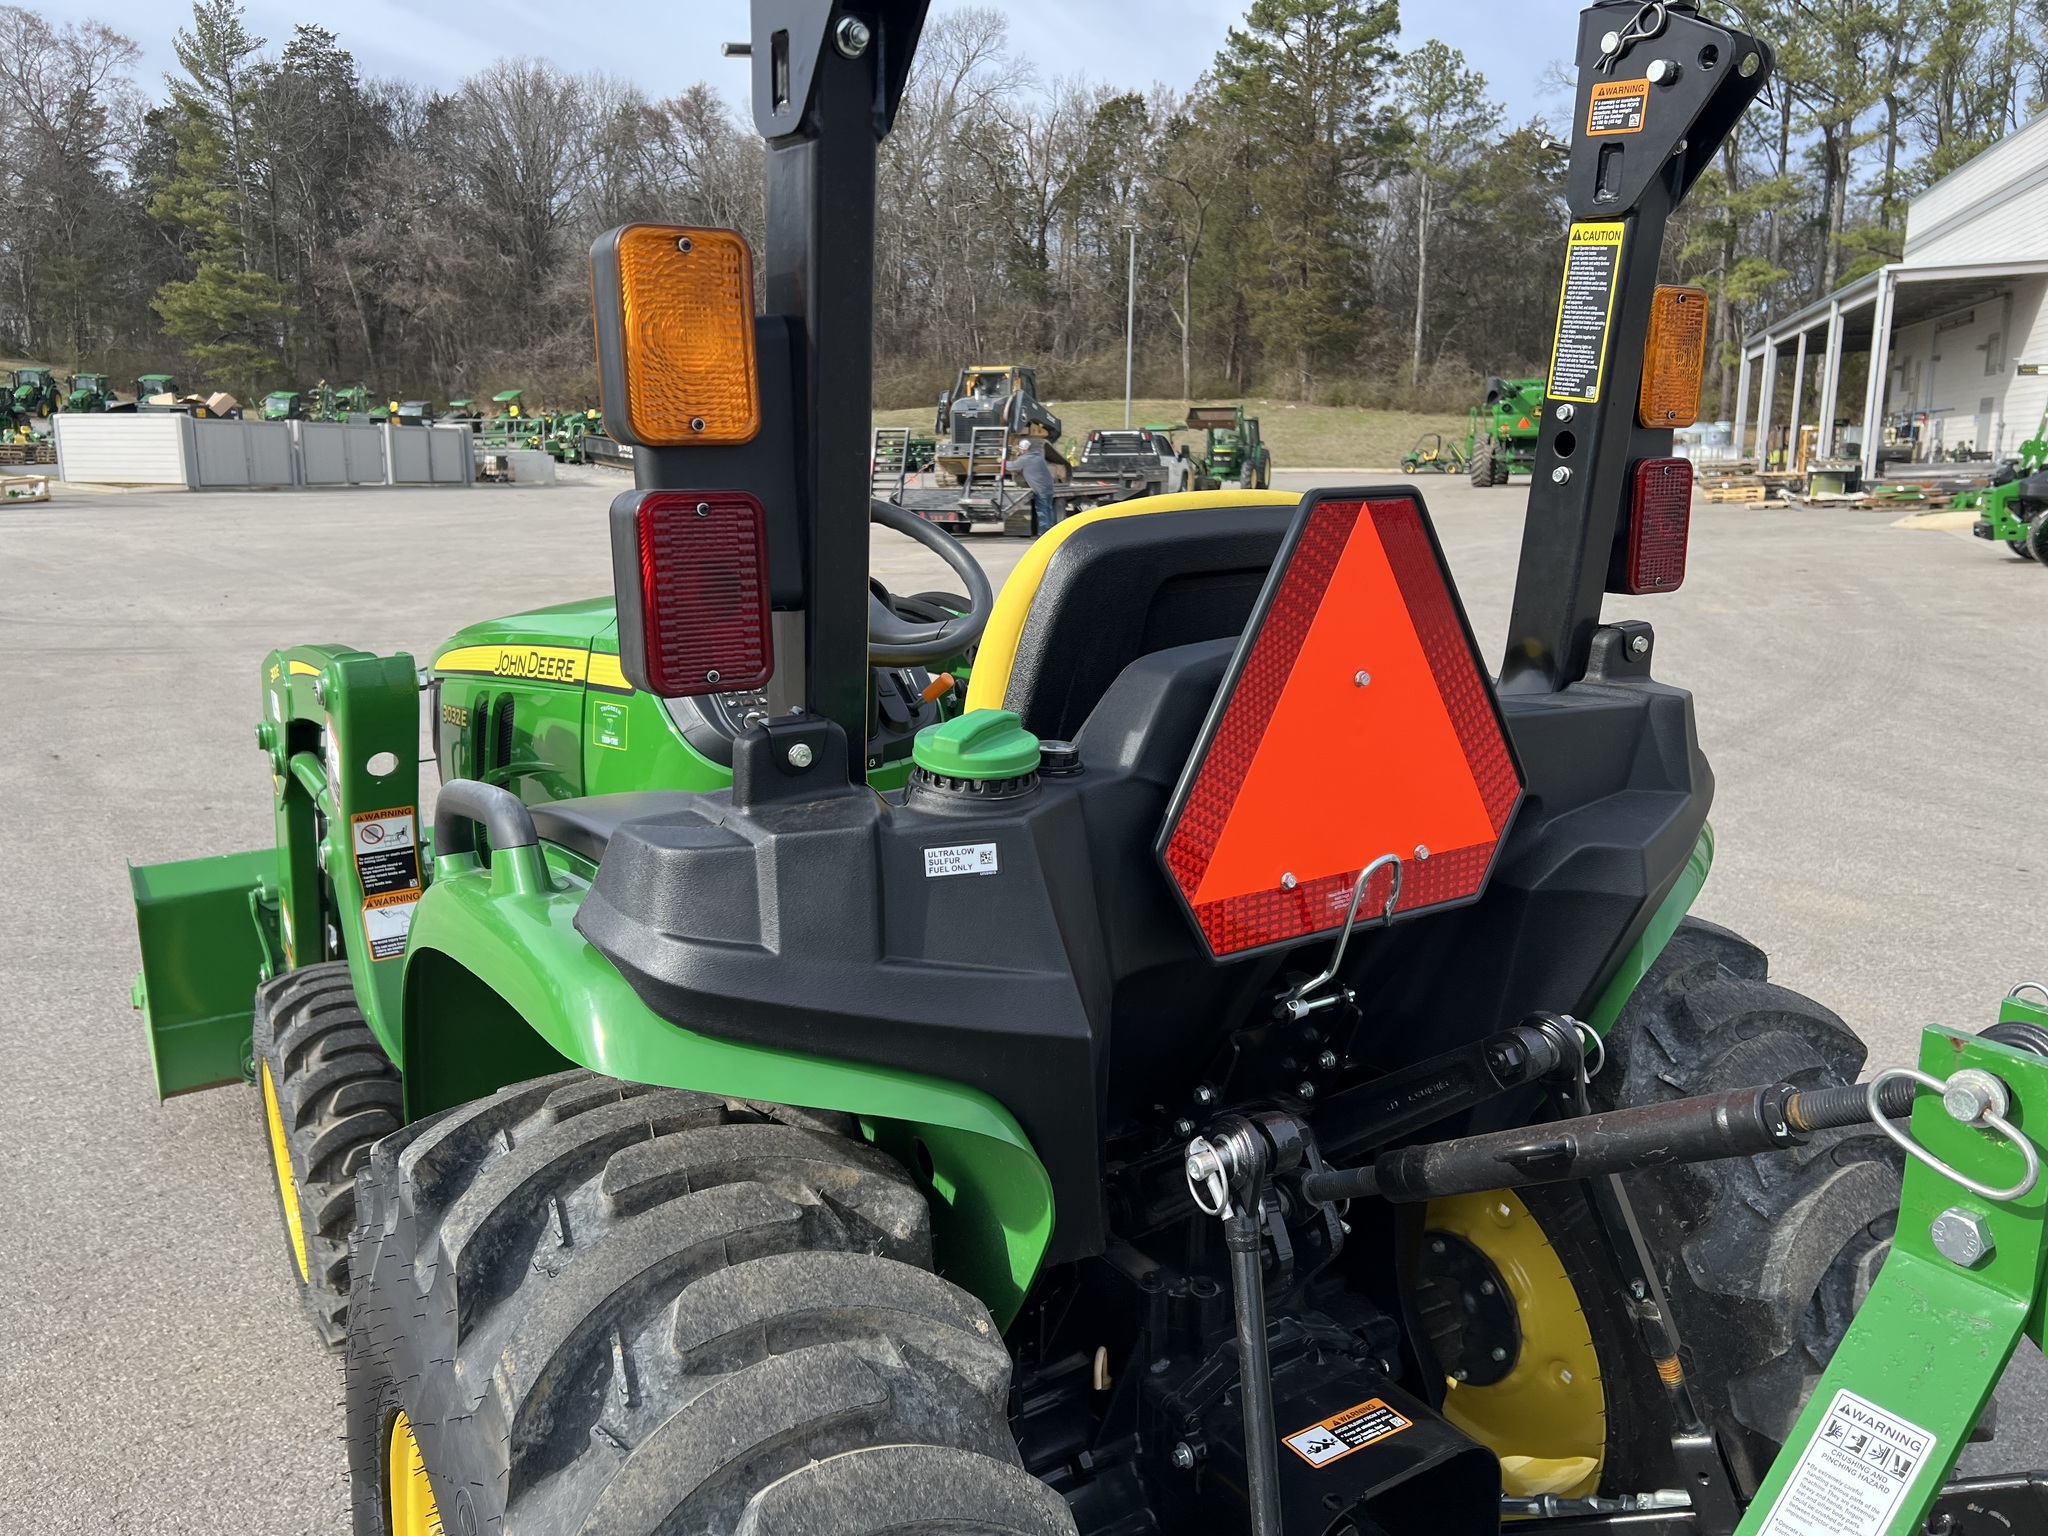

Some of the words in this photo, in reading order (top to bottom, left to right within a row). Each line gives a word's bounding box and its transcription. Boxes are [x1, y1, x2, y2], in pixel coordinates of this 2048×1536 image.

[1606, 84, 1644, 95] WARNING
[1582, 230, 1622, 241] CAUTION
[528, 651, 576, 679] DEERE
[443, 704, 468, 728] 3032E
[364, 808, 412, 821] WARNING
[928, 850, 955, 858] ULTRA
[929, 857, 960, 866] SULFUR
[929, 866, 949, 874] FUEL
[951, 864, 973, 872] ONLY
[374, 892, 420, 906] WARNING
[1340, 1404, 1376, 1422] WARNING
[1852, 1408, 1922, 1452] WARNING
[1821, 1453, 1857, 1476] PINCHING
[1858, 1473, 1889, 1494] HAZARD
[1831, 1449, 1870, 1473] CRUSHING
[1871, 1472, 1888, 1483] AND
[1807, 1470, 1829, 1486] handling
[1830, 1484, 1849, 1497] various
[1849, 1496, 1863, 1505] parts
[1871, 1507, 1880, 1515] the
[1818, 1469, 1843, 1486] extremely
[1844, 1484, 1863, 1496] careful
[1793, 1496, 1808, 1506] could
[1815, 1509, 1837, 1523] crushed
[1796, 1489, 1806, 1497] feet
[1817, 1502, 1831, 1511] other
[1832, 1509, 1845, 1520] body
[1845, 1519, 1860, 1528] parts
[1800, 1482, 1815, 1494] heavy
[1826, 1498, 1843, 1511] hands,
[1845, 1508, 1864, 1524] fingers,
[1803, 1477, 1825, 1491] machine.
[1828, 1490, 1840, 1501] They
[1850, 1504, 1876, 1521] extremely
[1778, 1520, 1798, 1535] Operate
[1785, 1508, 1812, 1527] implement.
[1789, 1501, 1810, 1516] between
[1811, 1514, 1828, 1527] tractor
[1829, 1526, 1840, 1534] and
